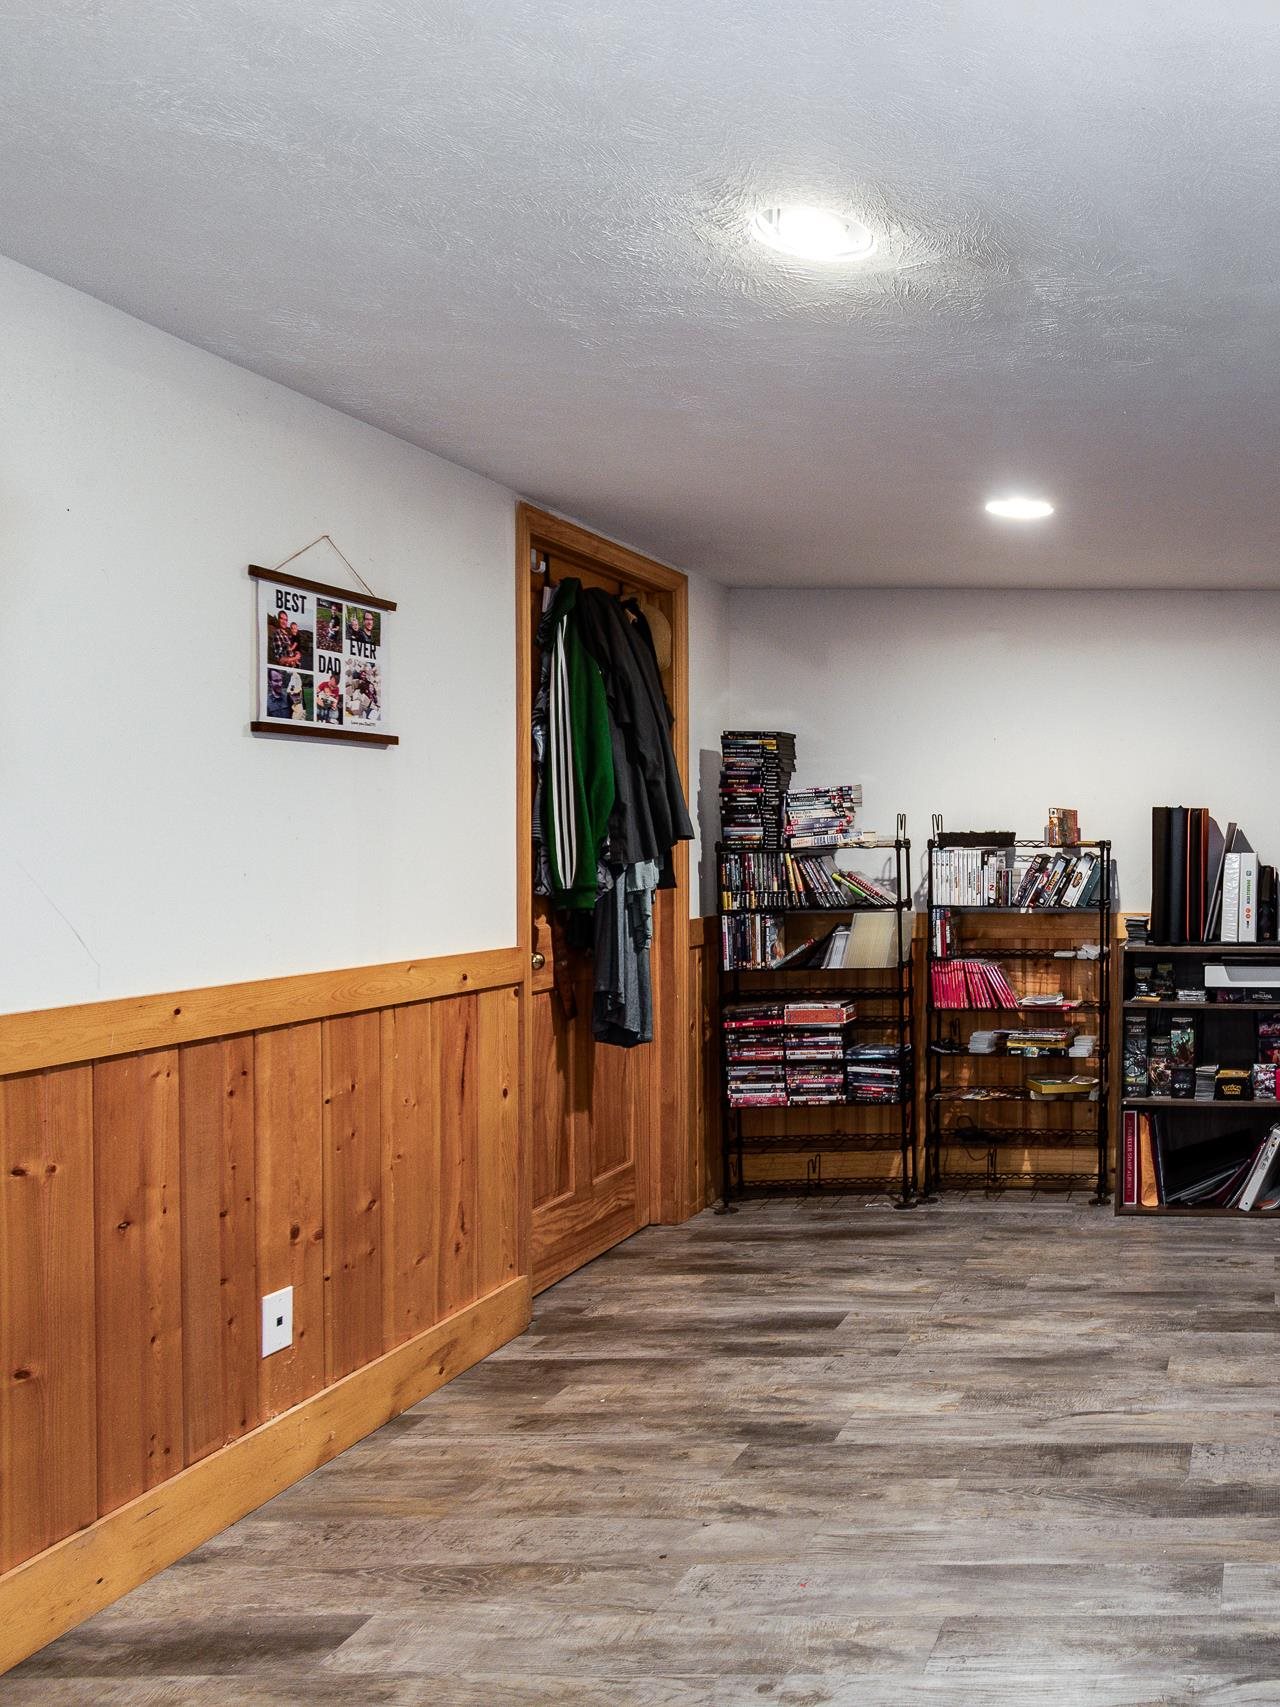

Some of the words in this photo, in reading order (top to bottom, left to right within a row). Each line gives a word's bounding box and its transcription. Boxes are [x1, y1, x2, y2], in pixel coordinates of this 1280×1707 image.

[275, 589, 307, 614] BEST
[350, 640, 376, 660] EVER
[318, 654, 341, 675] DAD
